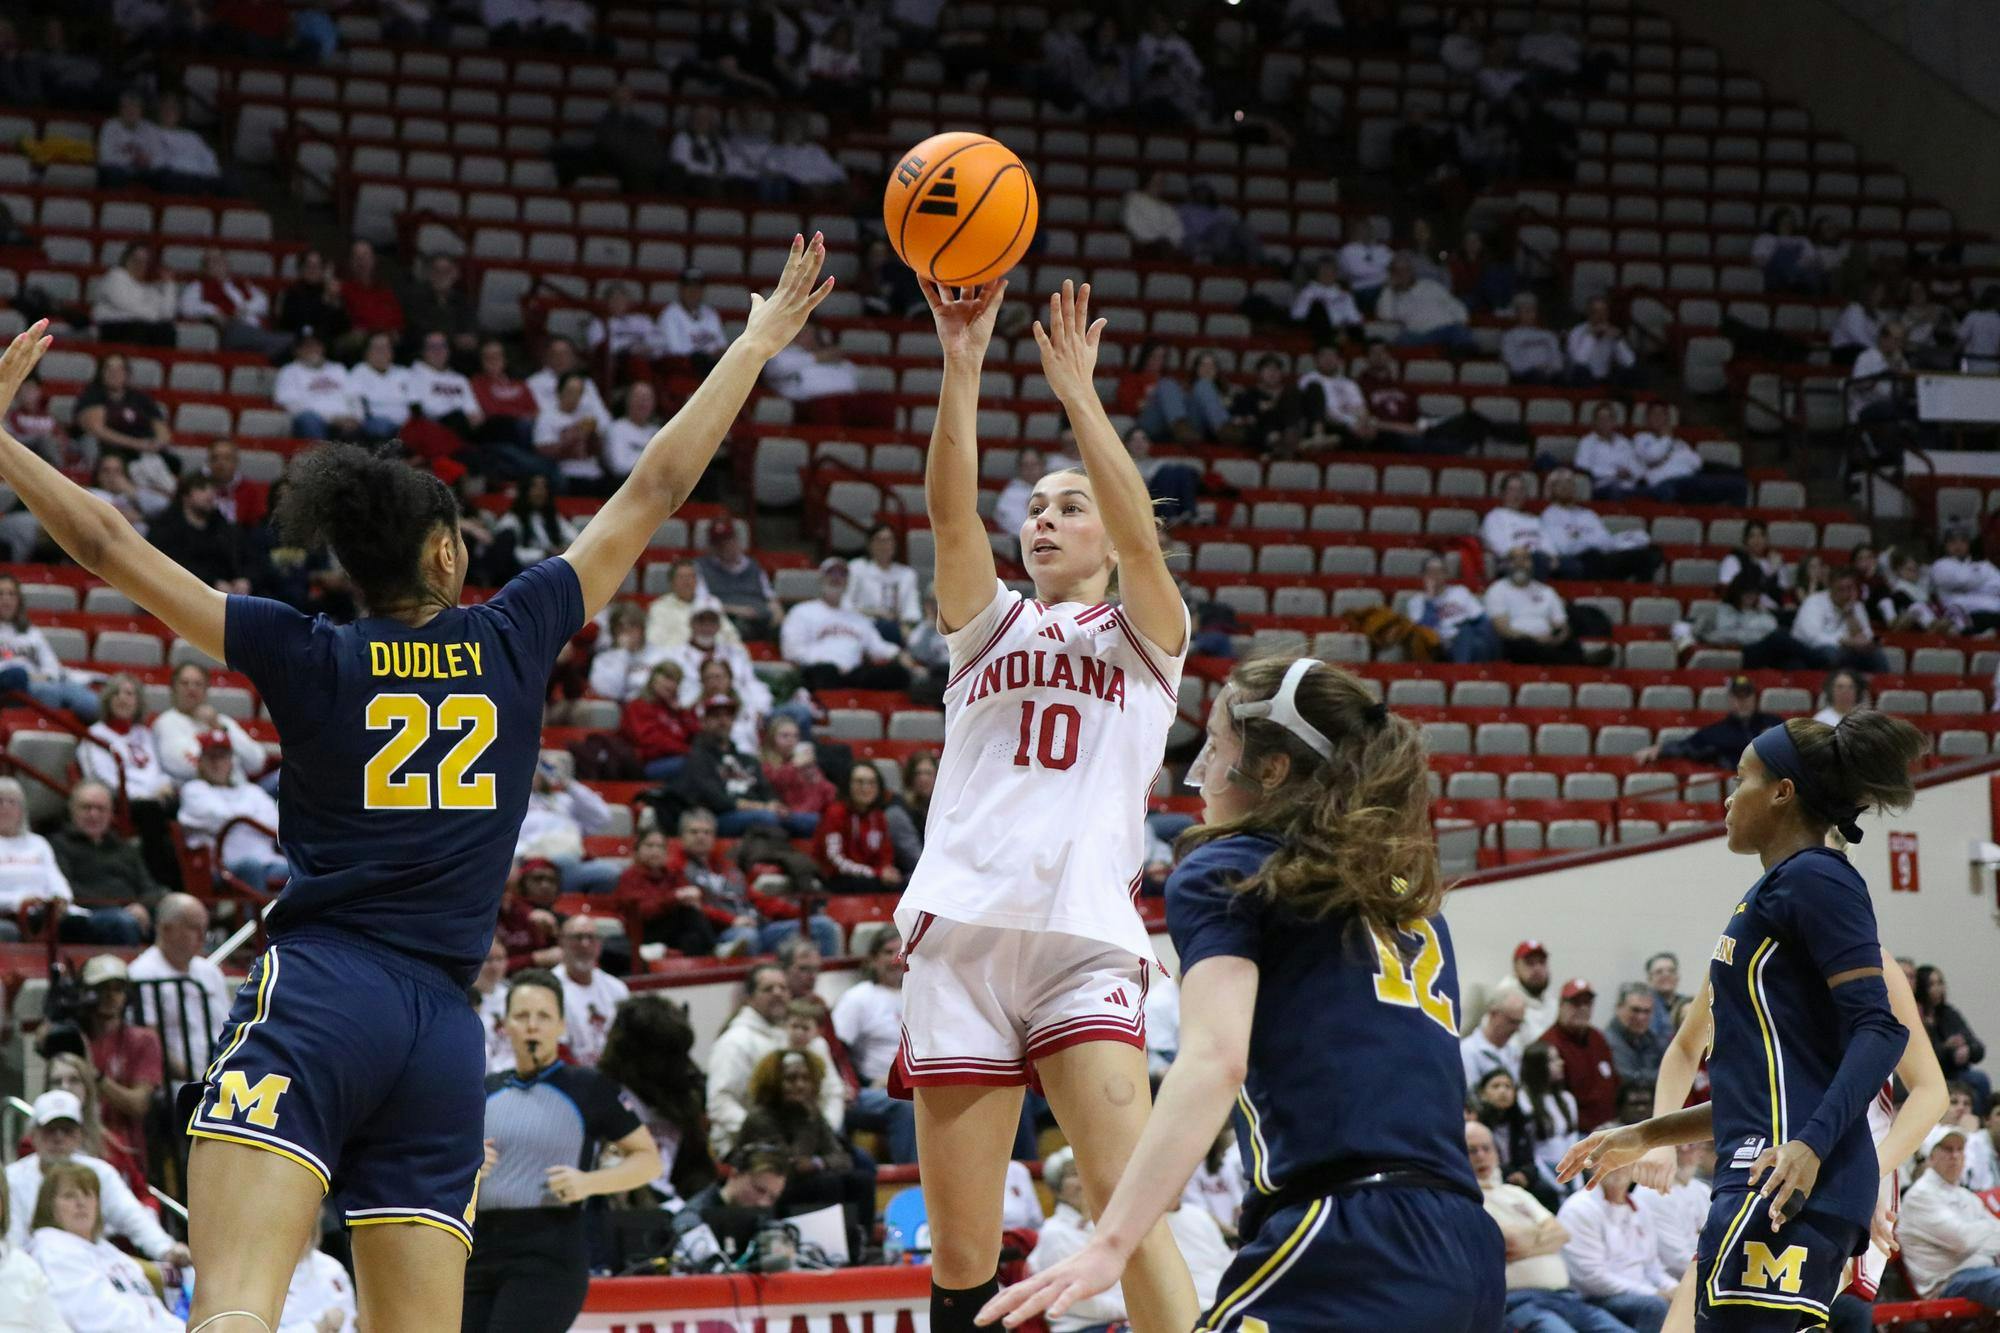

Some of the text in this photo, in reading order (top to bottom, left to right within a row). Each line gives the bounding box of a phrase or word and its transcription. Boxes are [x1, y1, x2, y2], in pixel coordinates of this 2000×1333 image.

[370, 641, 483, 679] DUDLEY
[966, 650, 1125, 713] INDIANA
[364, 693, 498, 810] 22
[1013, 700, 1082, 771] 10
[1361, 915, 1460, 1037] 12
[207, 1070, 292, 1130] M
[1741, 1240, 1808, 1294] M
